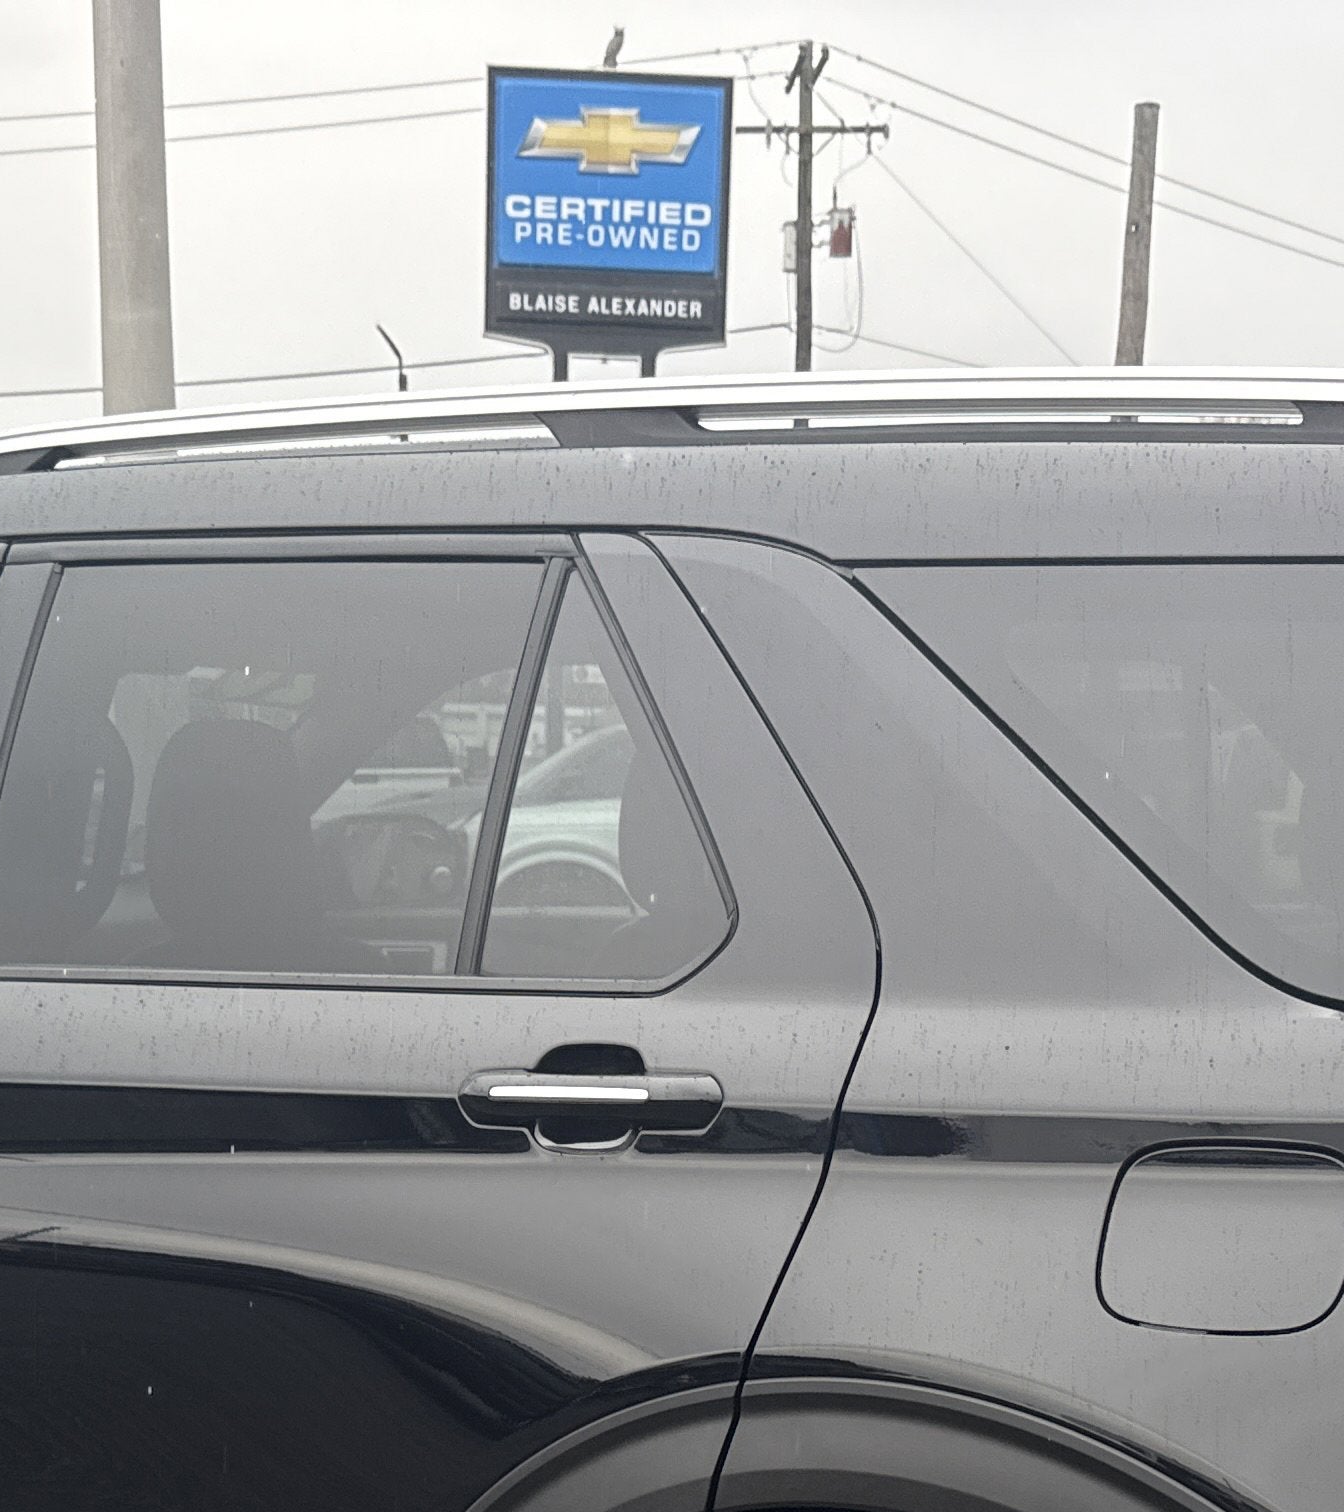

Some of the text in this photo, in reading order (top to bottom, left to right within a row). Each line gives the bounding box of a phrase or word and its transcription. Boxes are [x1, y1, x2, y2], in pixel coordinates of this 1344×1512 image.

[505, 195, 712, 227] CERTIFIED
[515, 222, 701, 251] PRE-OWNED
[509, 293, 703, 318] BLAISE ALEXANDER
